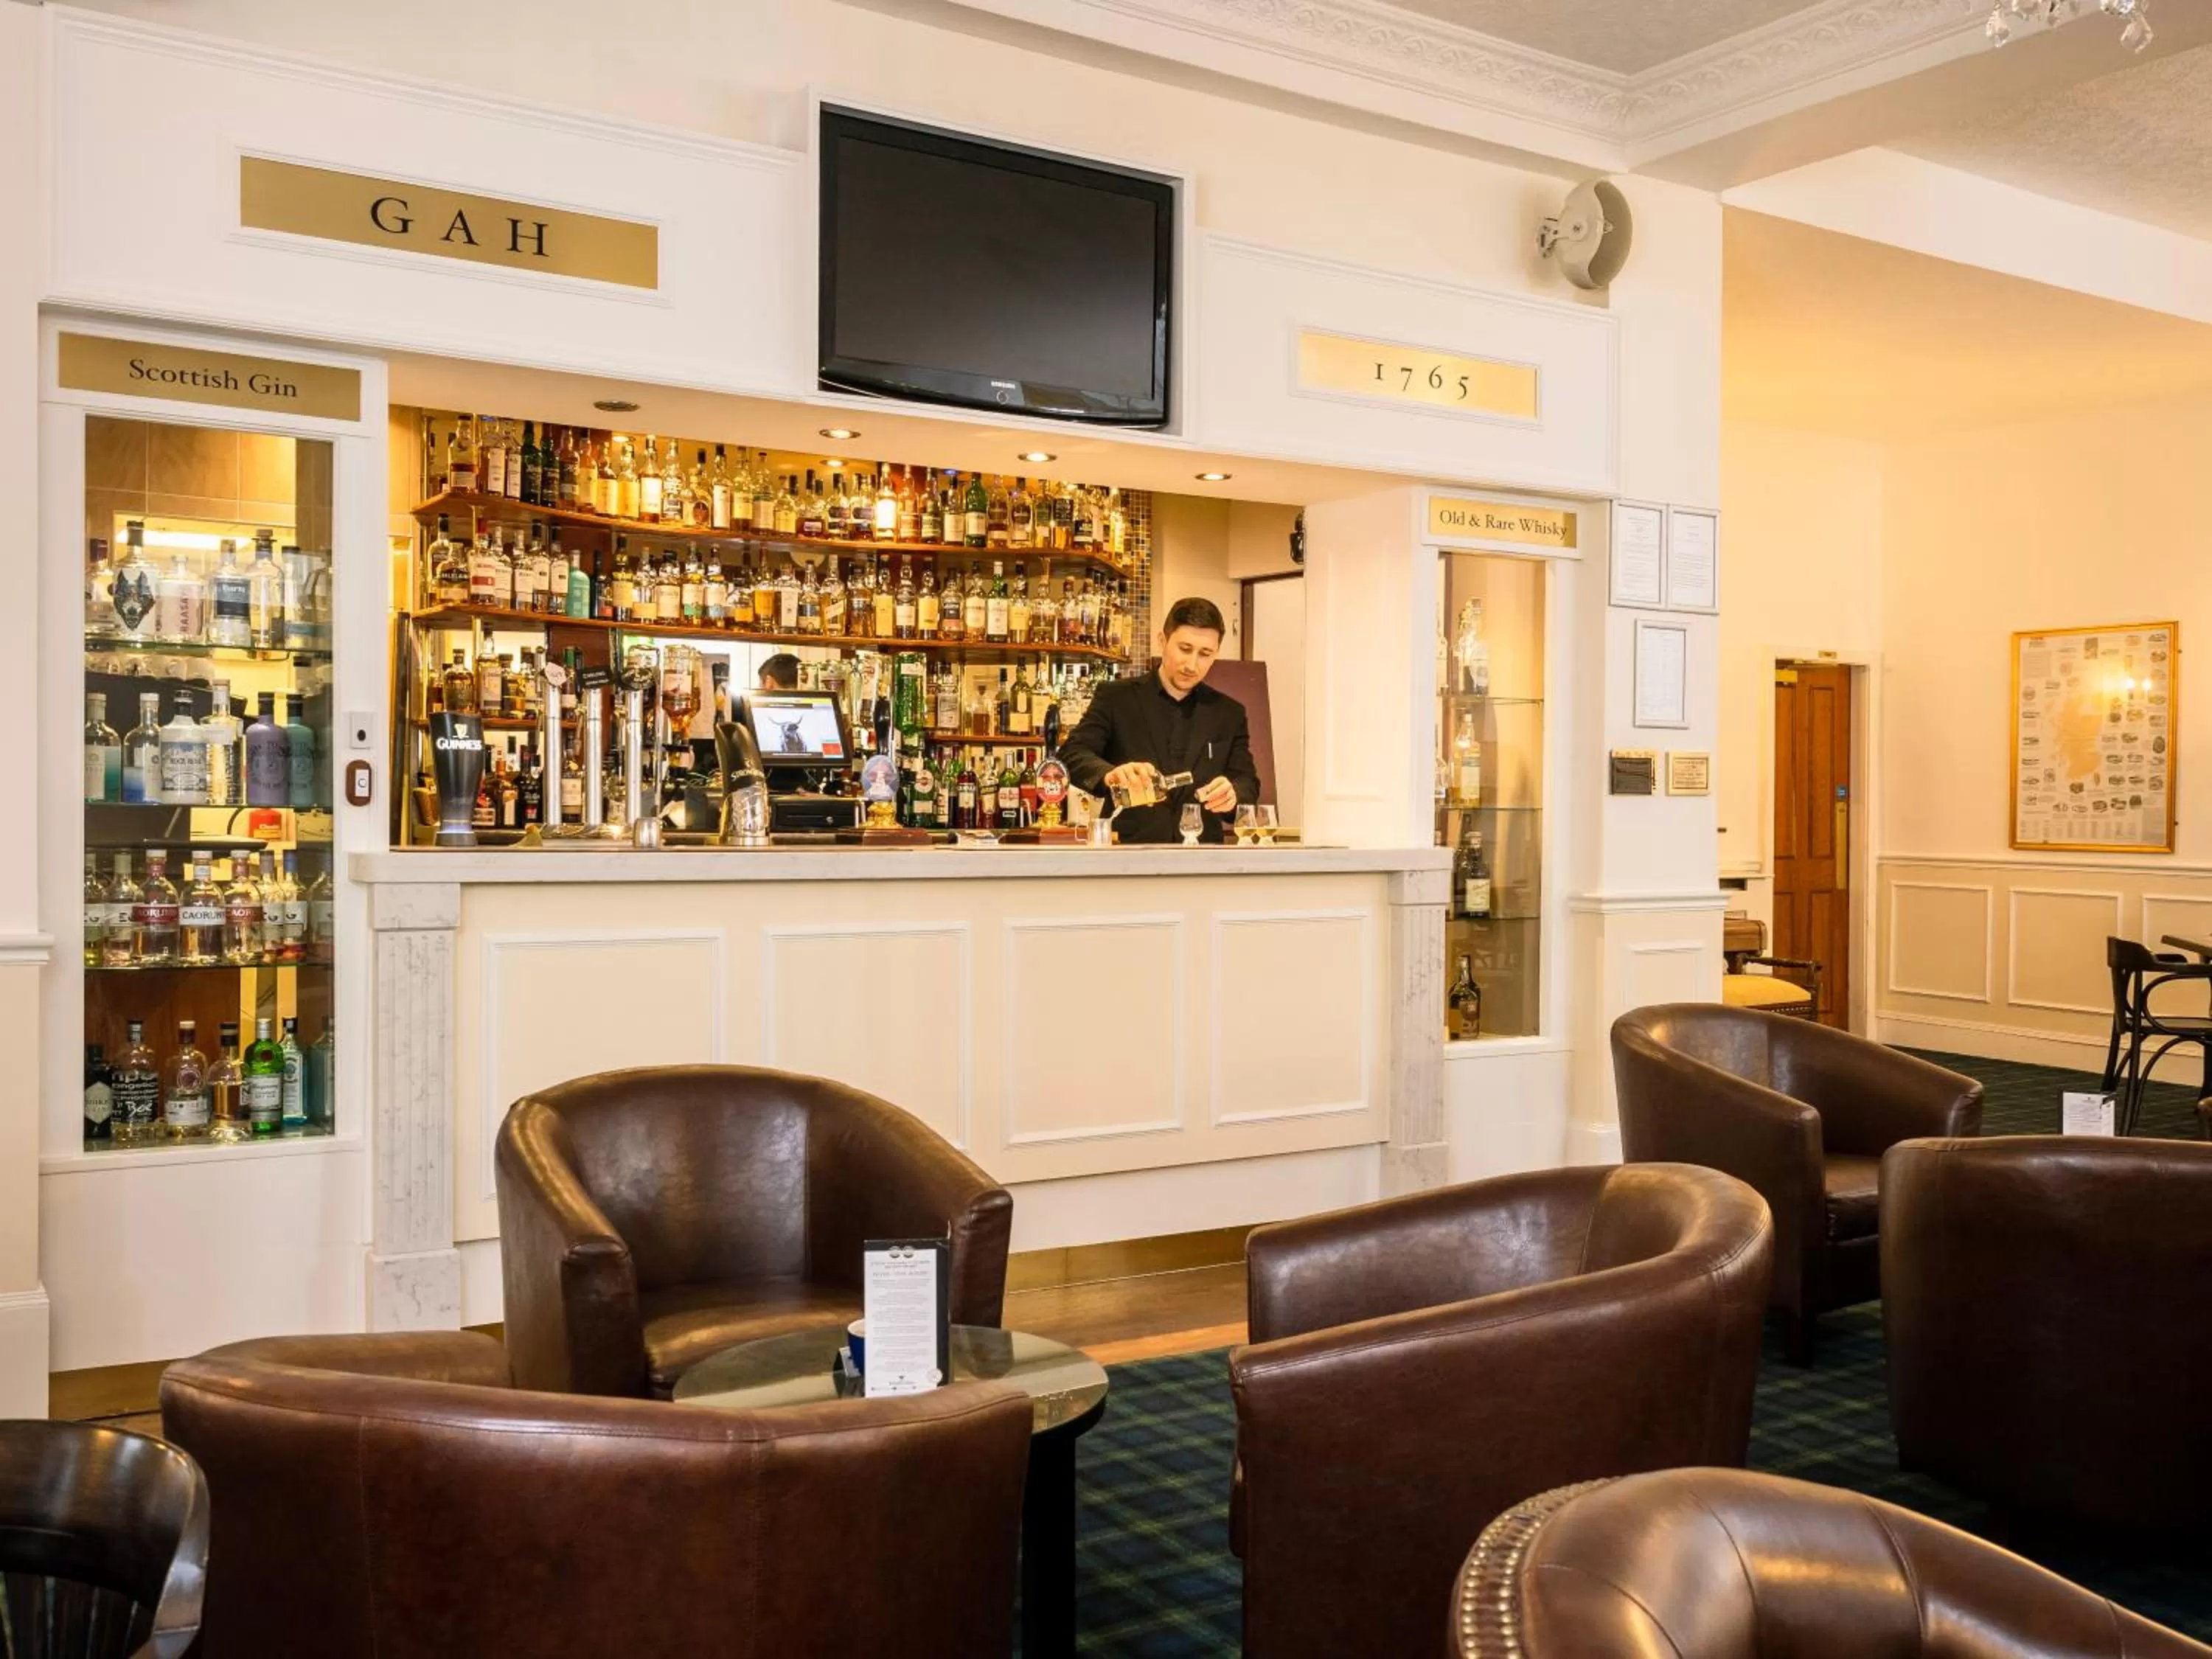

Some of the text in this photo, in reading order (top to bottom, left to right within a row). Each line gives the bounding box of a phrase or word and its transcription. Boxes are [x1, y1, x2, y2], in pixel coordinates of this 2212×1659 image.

[129, 358, 298, 398] Scottish Gin
[1439, 509, 1568, 540] Old & Rare Whisky
[437, 737, 482, 750] GUINNESS
